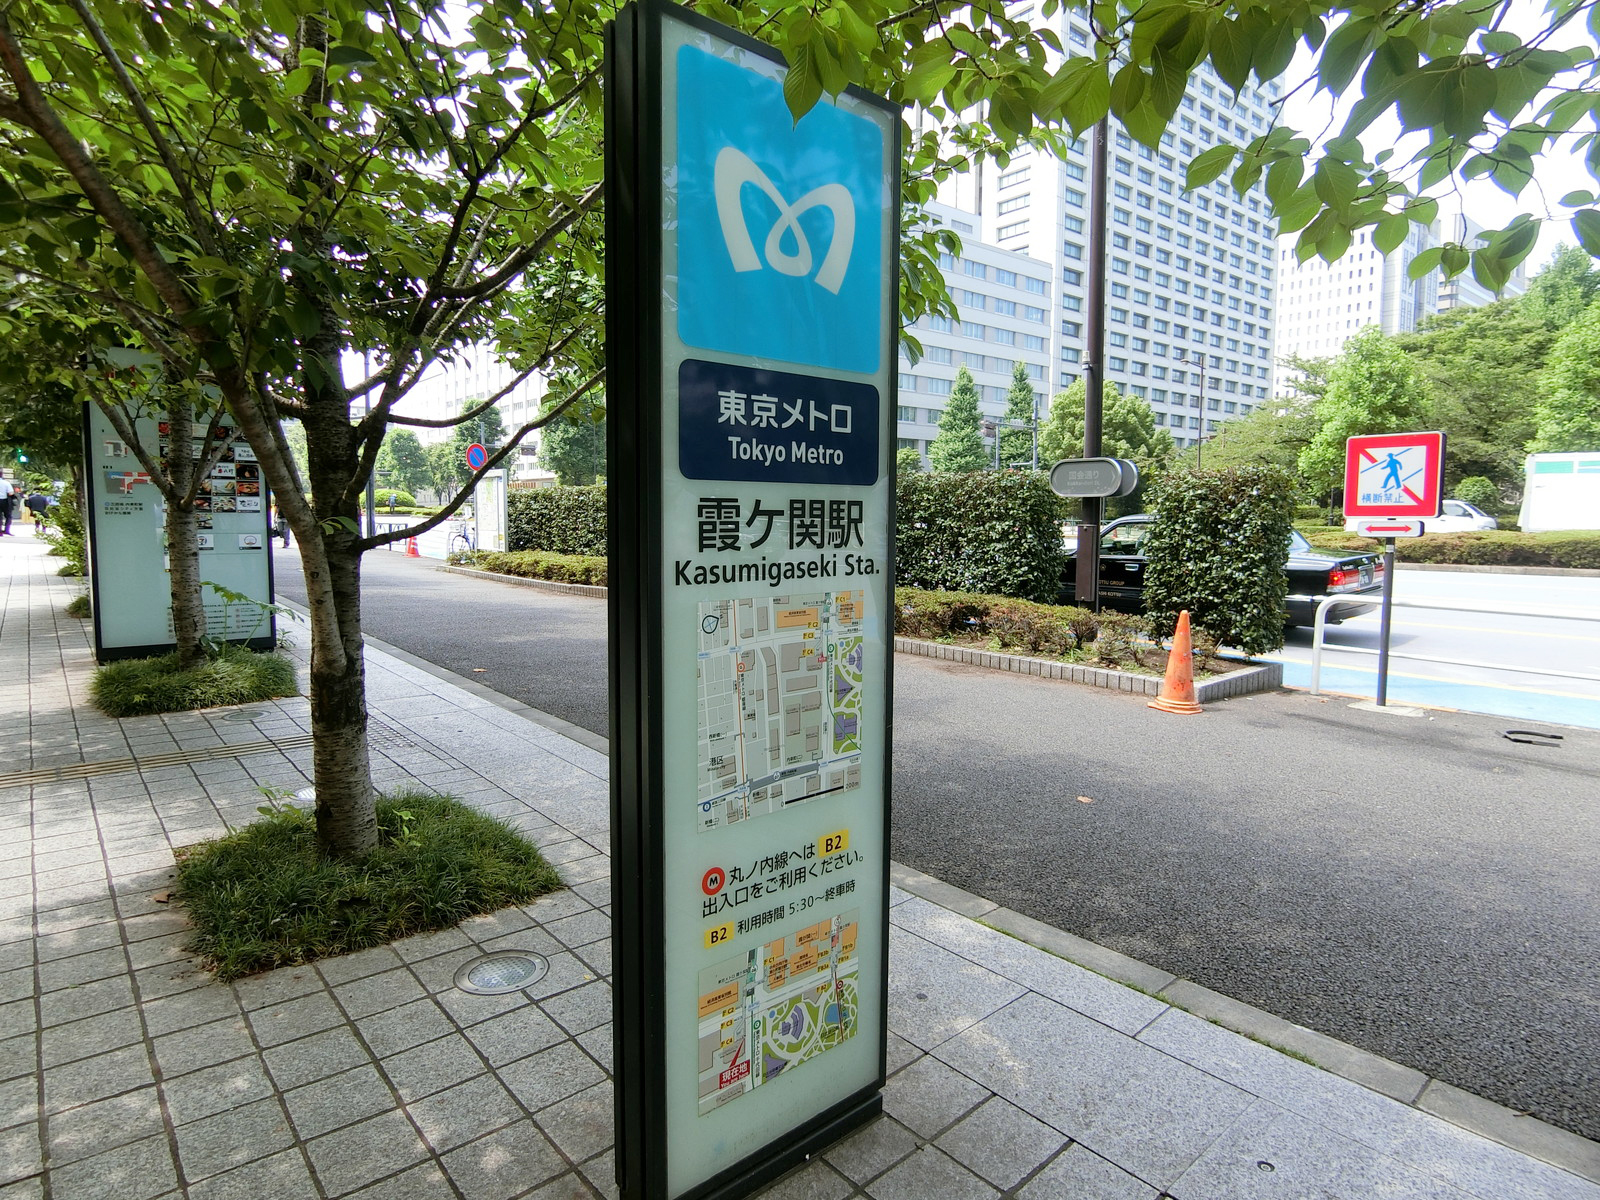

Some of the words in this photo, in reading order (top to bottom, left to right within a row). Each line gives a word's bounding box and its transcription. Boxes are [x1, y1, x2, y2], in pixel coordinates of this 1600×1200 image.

[718, 390, 852, 434] 東京メトロ
[728, 436, 786, 466] Tokyo
[791, 441, 844, 465] Metro
[1361, 493, 1403, 504] 横断禁止
[697, 497, 864, 552] 霞ケ関駅
[675, 553, 837, 587] Kasumigaseki
[844, 554, 880, 576] Sta.
[709, 755, 723, 766] 港区
[729, 843, 816, 886] 丸ノ内線へは
[825, 835, 842, 853] B2
[703, 850, 864, 919] 出入口をご利用ください。
[709, 875, 718, 887] M
[737, 906, 785, 935] 利用時間
[710, 927, 727, 944] B2
[722, 1063, 748, 1080] 現在地
